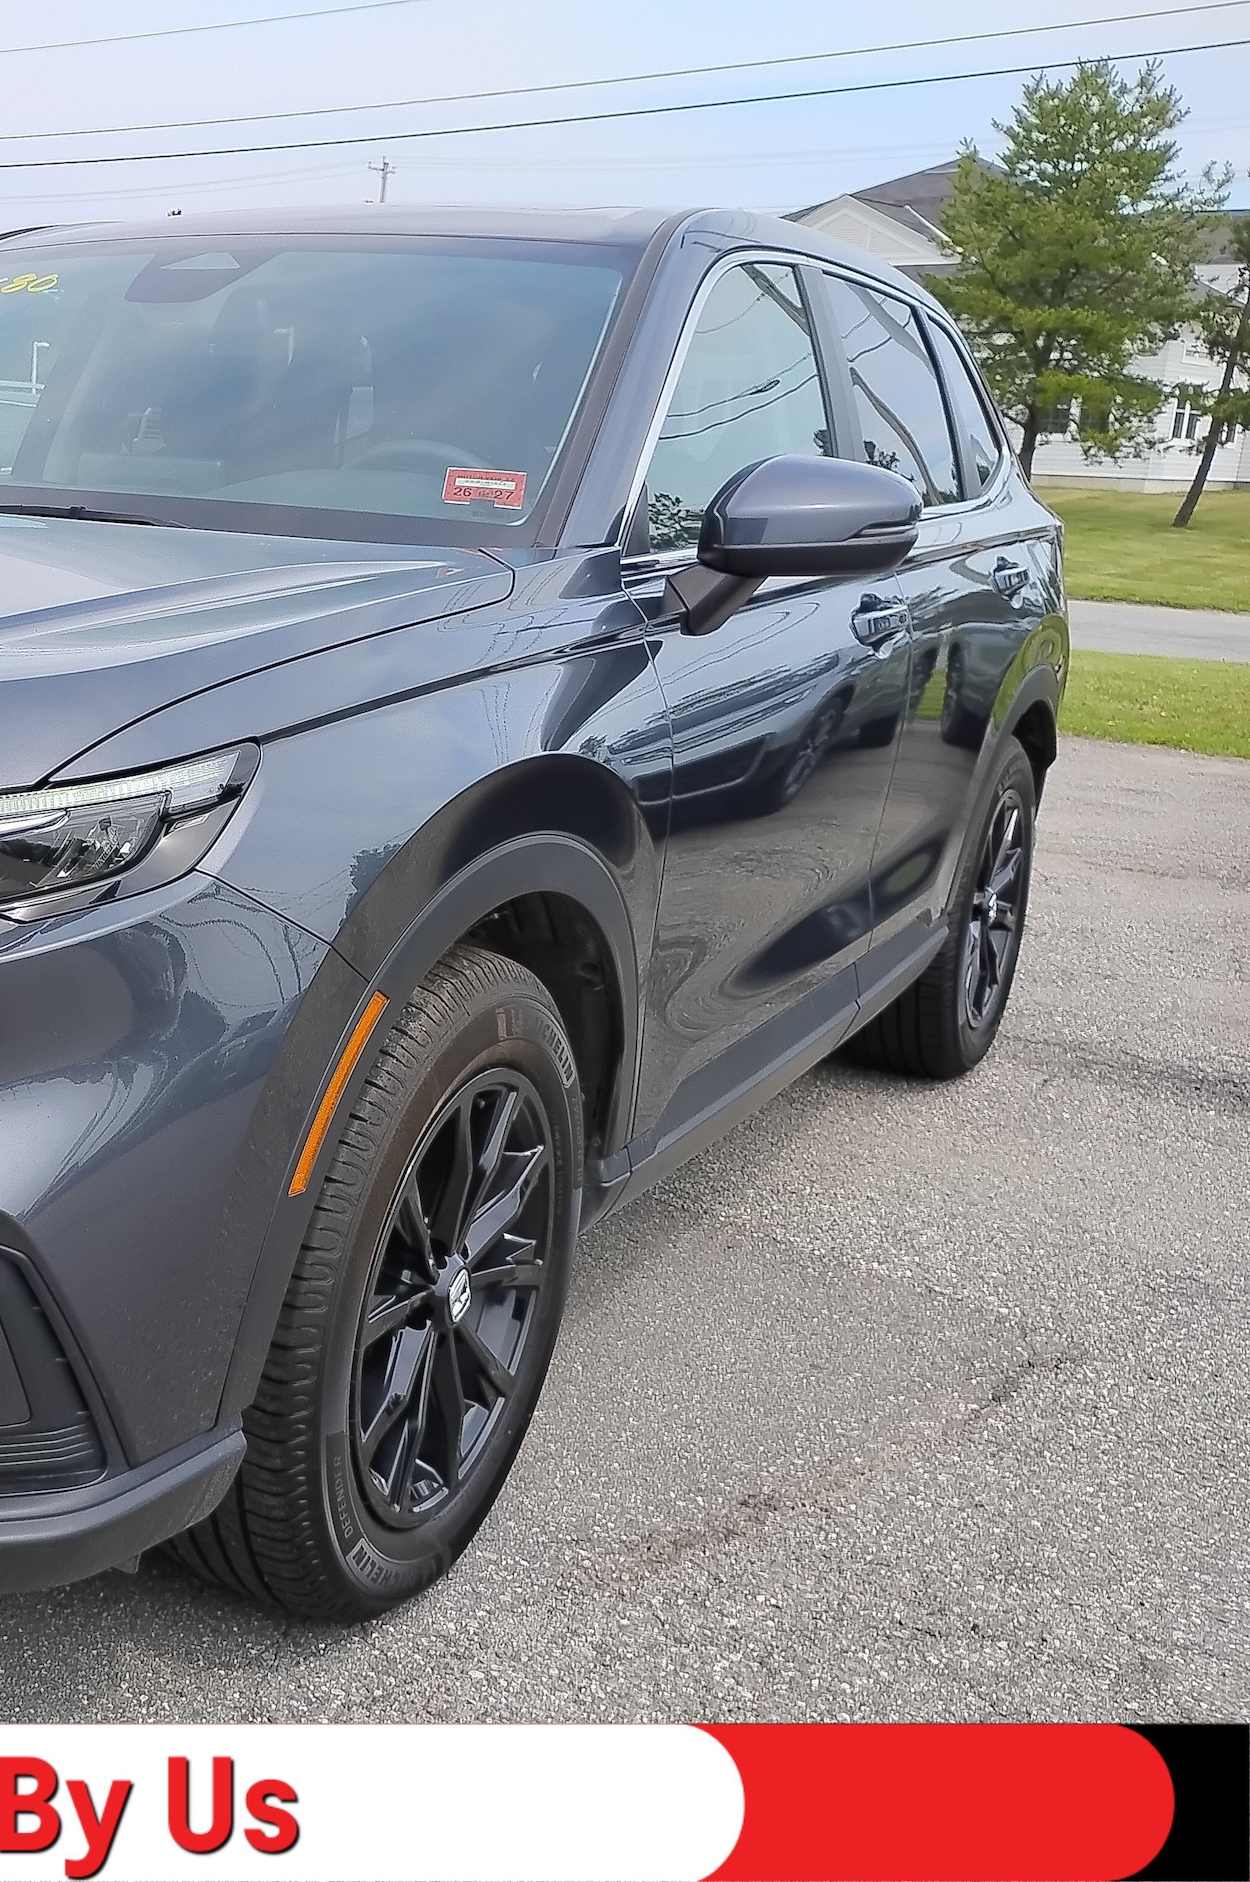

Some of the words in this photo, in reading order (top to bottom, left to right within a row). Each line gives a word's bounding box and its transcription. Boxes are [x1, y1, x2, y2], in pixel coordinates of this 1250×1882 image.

[453, 486, 472, 498] 26
[494, 489, 515, 500] 27
[333, 1455, 354, 1539] DEFENDER
